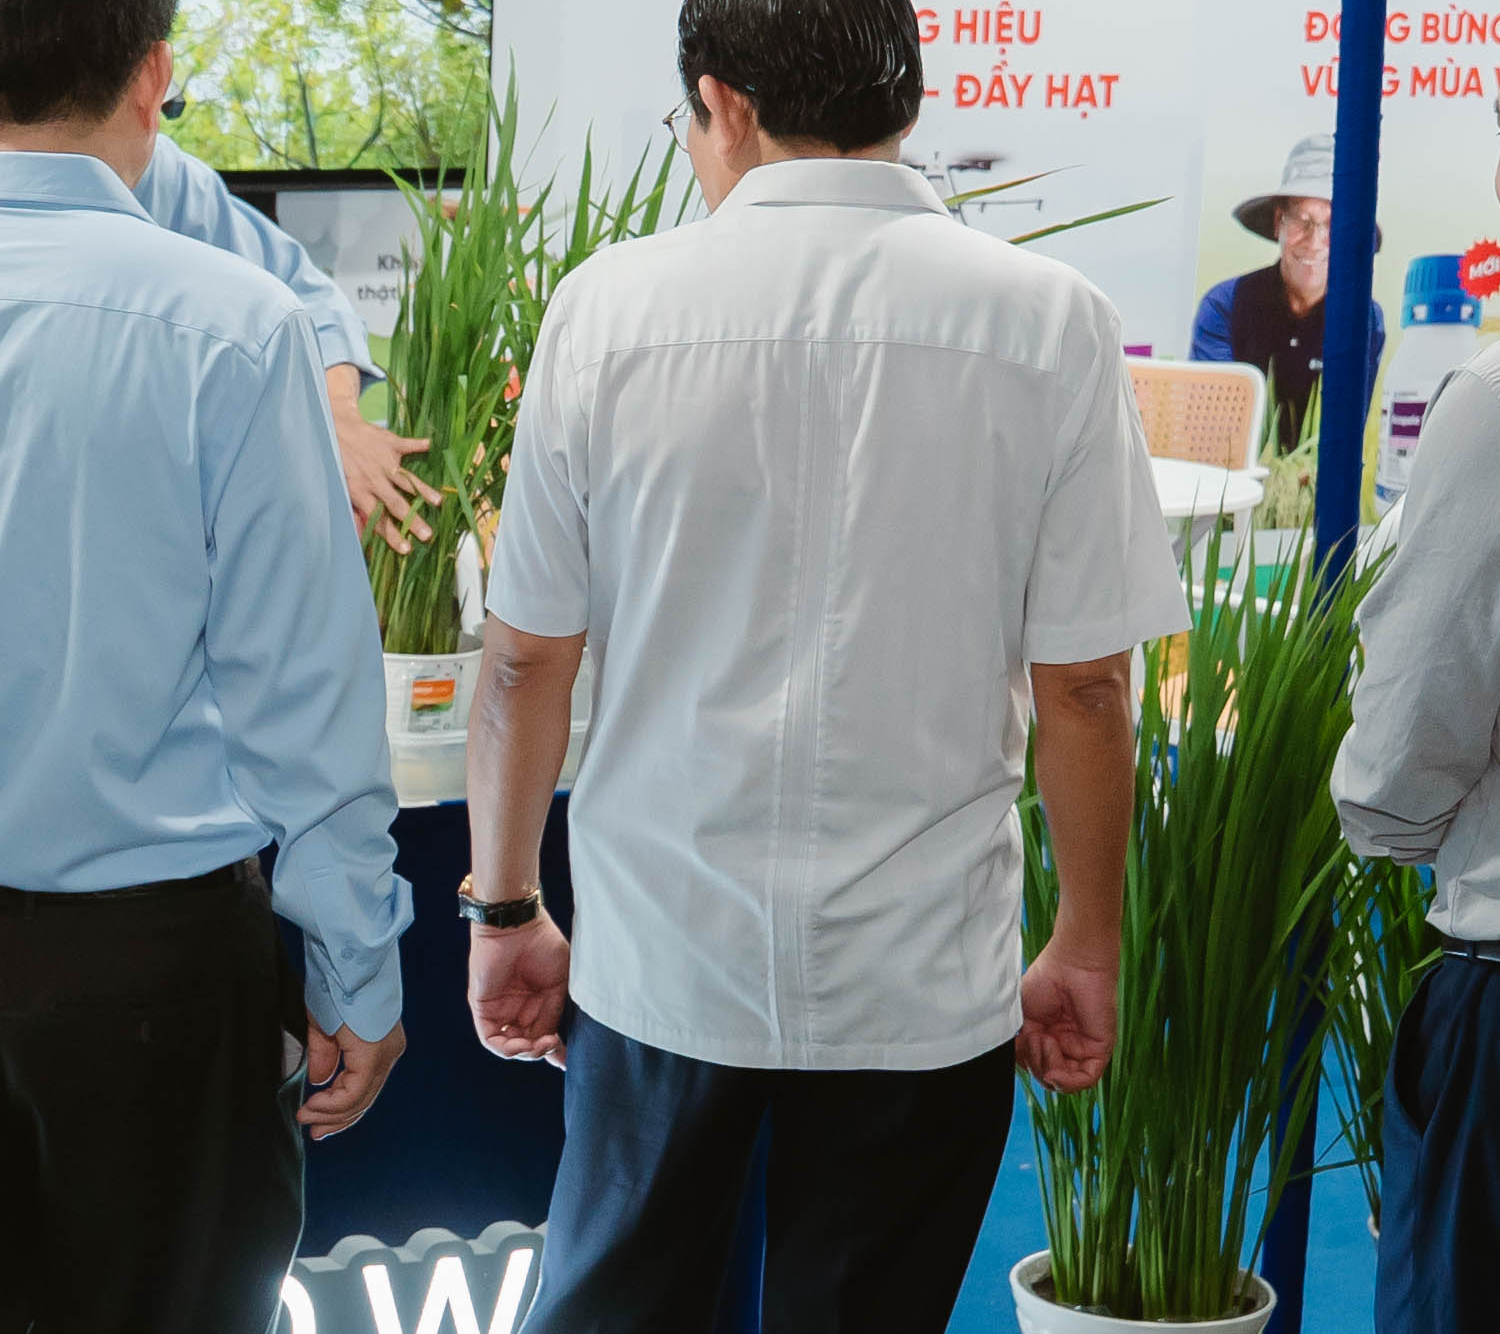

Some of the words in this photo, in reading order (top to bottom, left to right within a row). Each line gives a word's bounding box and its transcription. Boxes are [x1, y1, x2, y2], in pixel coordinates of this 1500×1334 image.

[953, 1, 1042, 55] HIỆU
[1045, 74, 1120, 120] HẠT
[1409, 64, 1485, 100] MÙA
